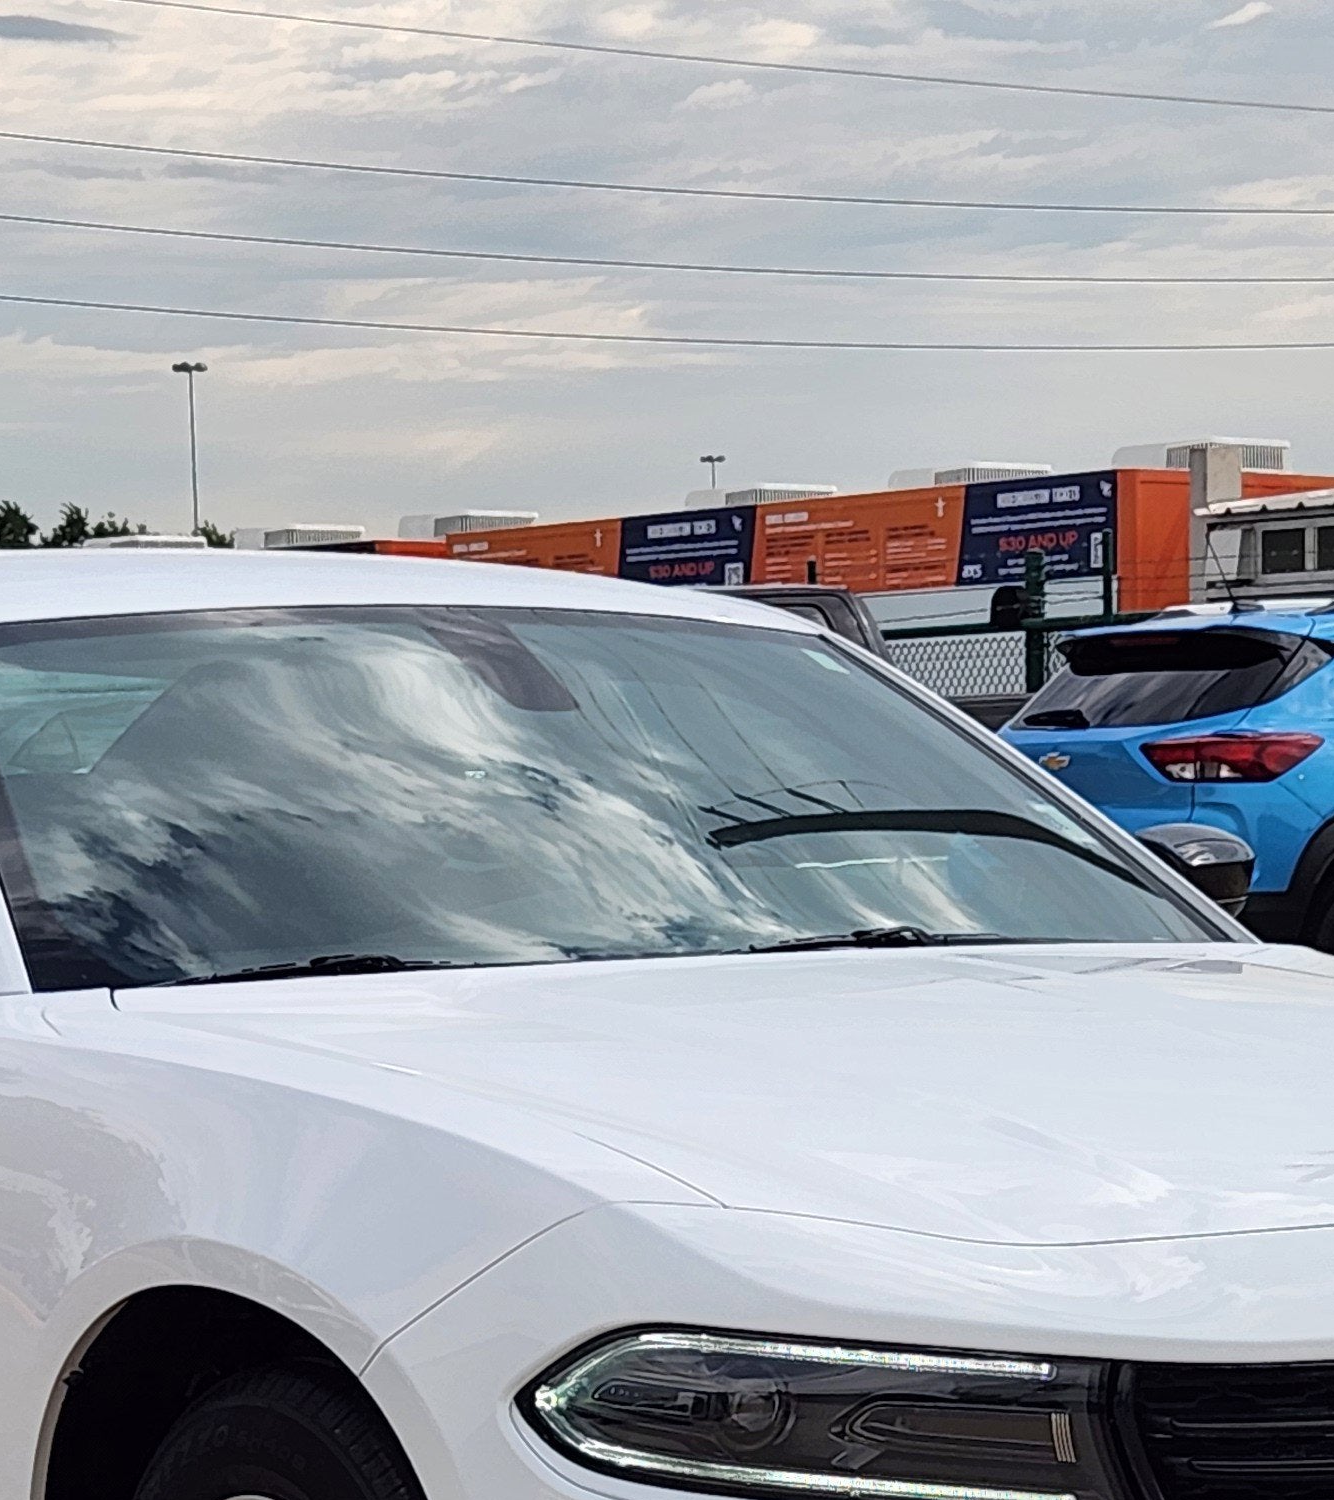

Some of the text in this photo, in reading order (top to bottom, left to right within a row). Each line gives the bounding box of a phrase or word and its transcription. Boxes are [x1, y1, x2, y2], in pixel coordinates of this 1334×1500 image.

[1028, 532, 1057, 549] AND
[1059, 530, 1079, 548] UP
[671, 563, 697, 577] AND
